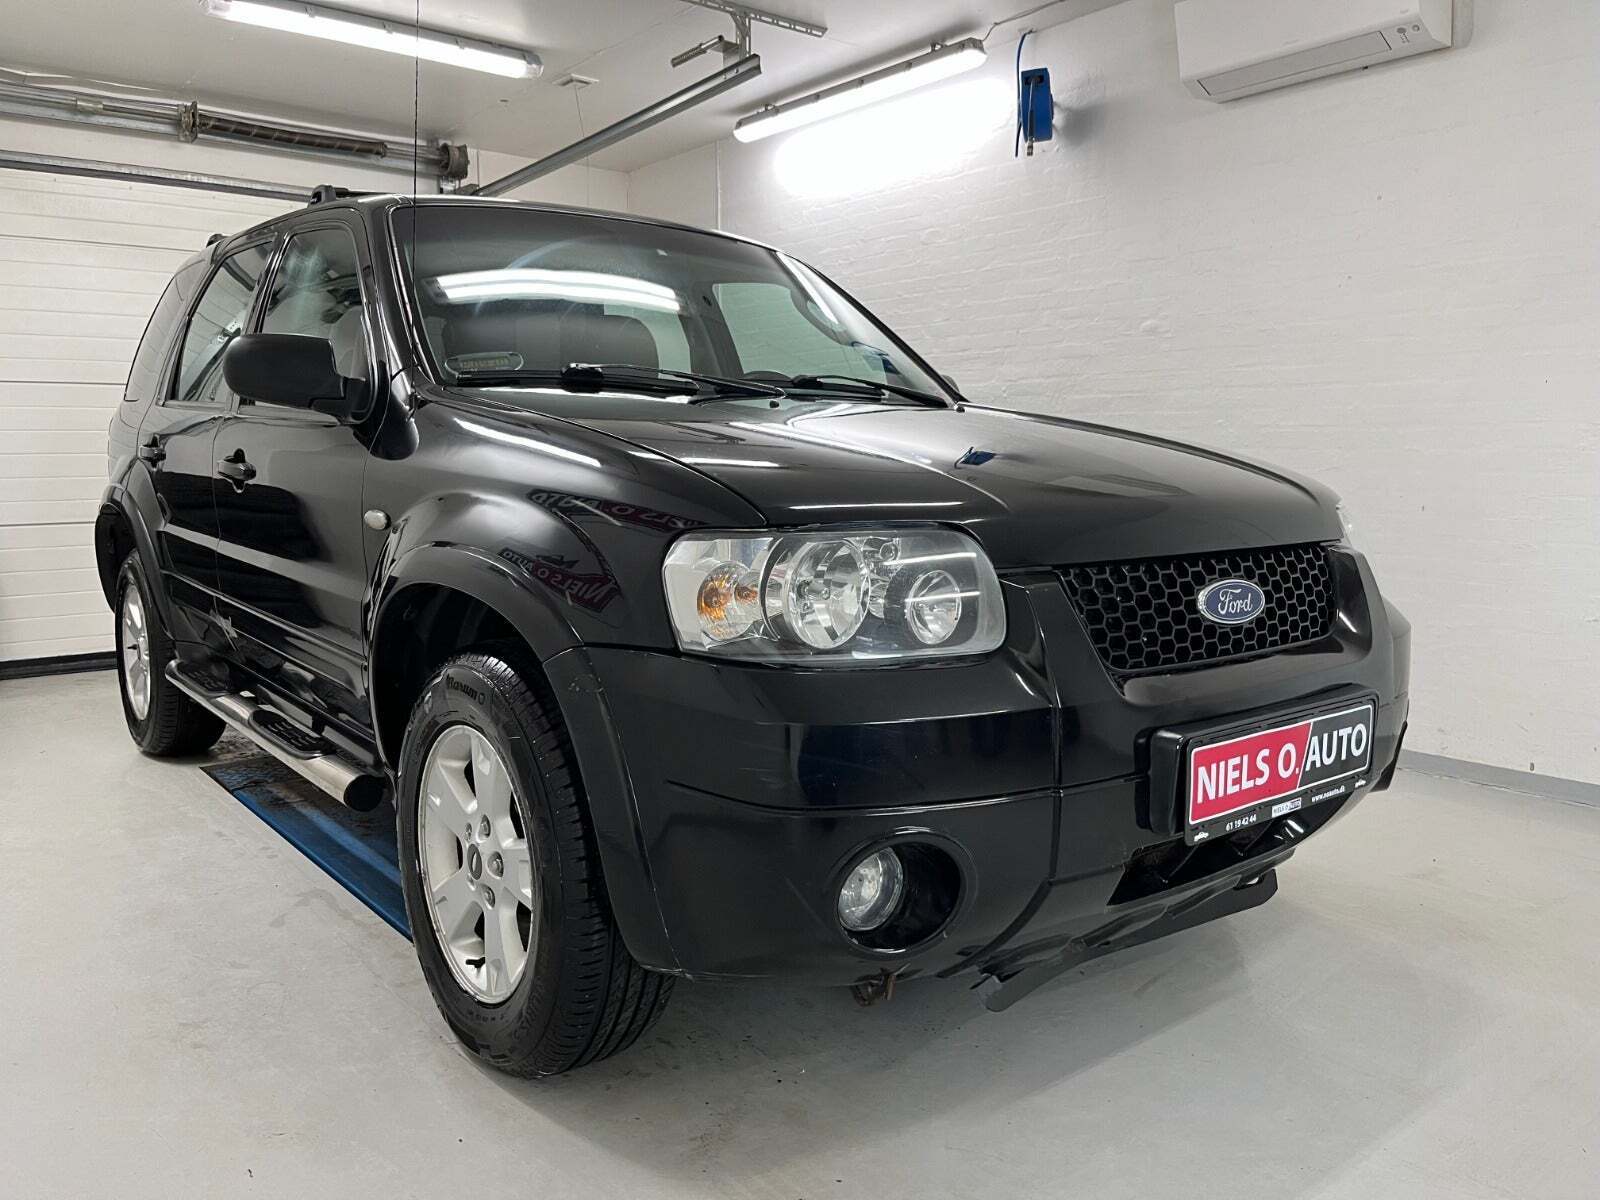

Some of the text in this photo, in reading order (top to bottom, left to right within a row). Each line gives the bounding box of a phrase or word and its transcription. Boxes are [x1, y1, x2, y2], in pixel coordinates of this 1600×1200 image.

[1218, 588, 1253, 615] Ford
[1197, 723, 1367, 804] NIELS O. AUTO
